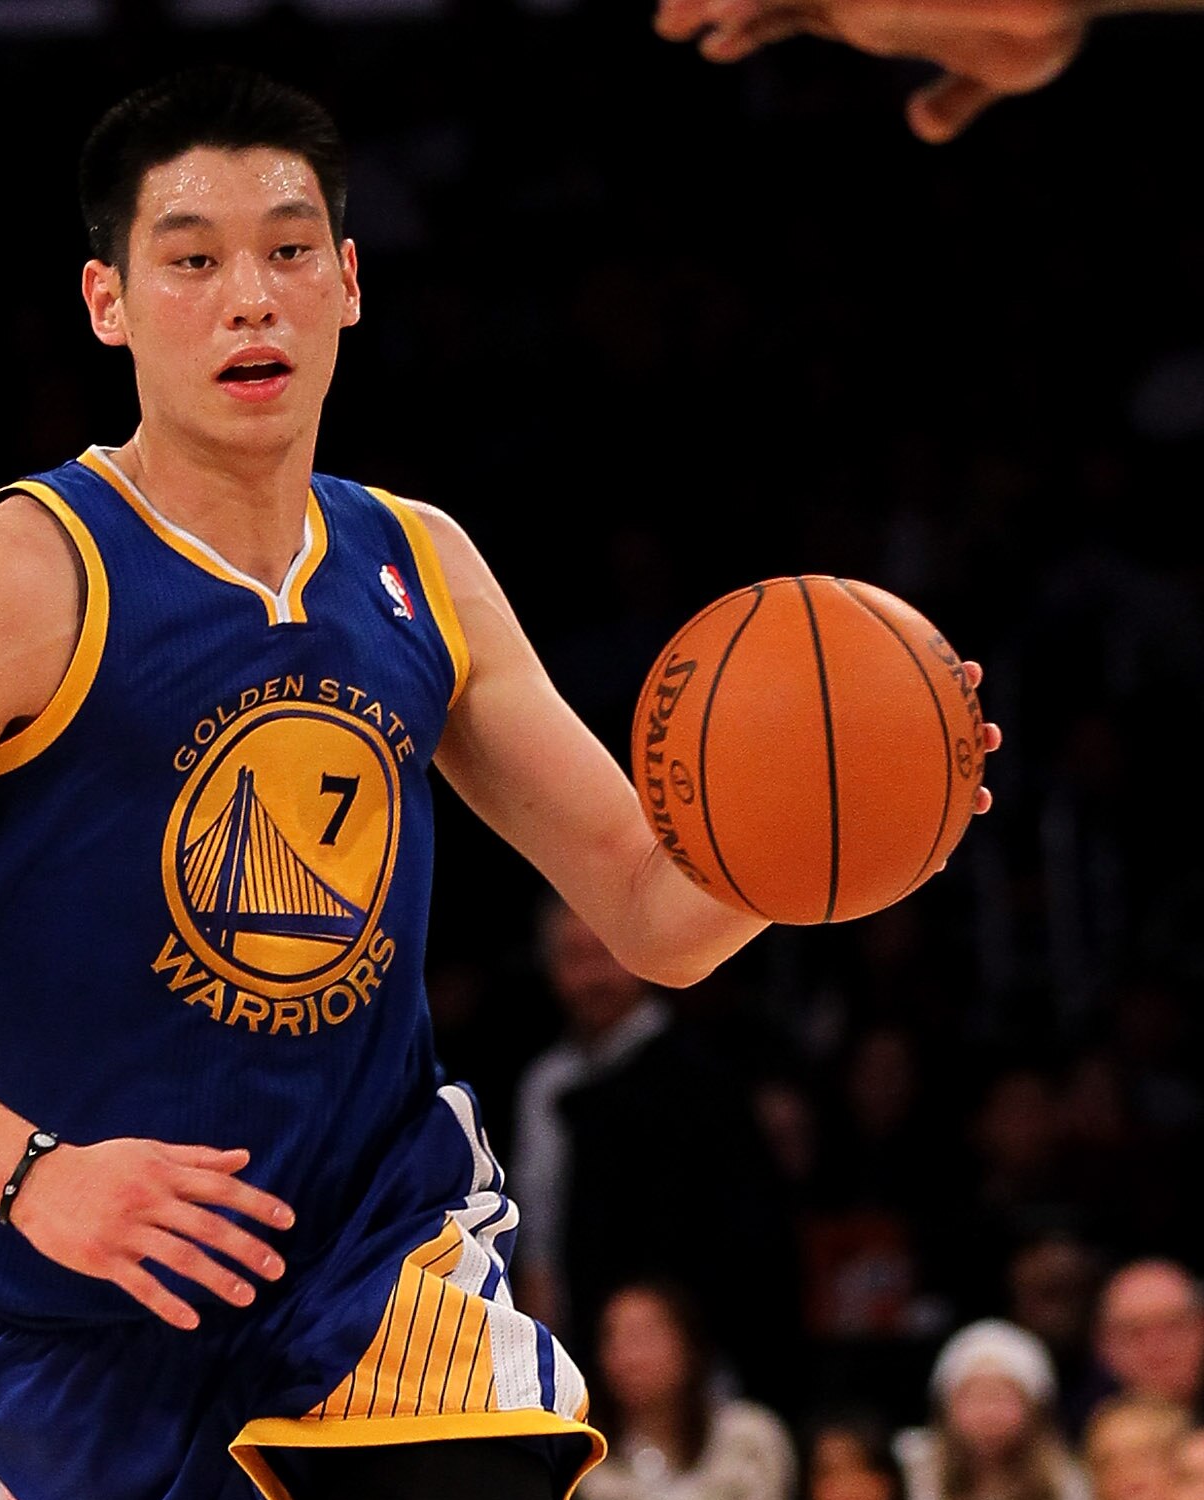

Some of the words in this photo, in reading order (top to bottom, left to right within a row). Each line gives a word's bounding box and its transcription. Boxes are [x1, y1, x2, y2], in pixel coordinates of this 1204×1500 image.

[172, 674, 305, 773] GOLDEN
[317, 677, 416, 764] STATE
[319, 770, 361, 847] 7
[150, 927, 396, 1038] WARRIORS
